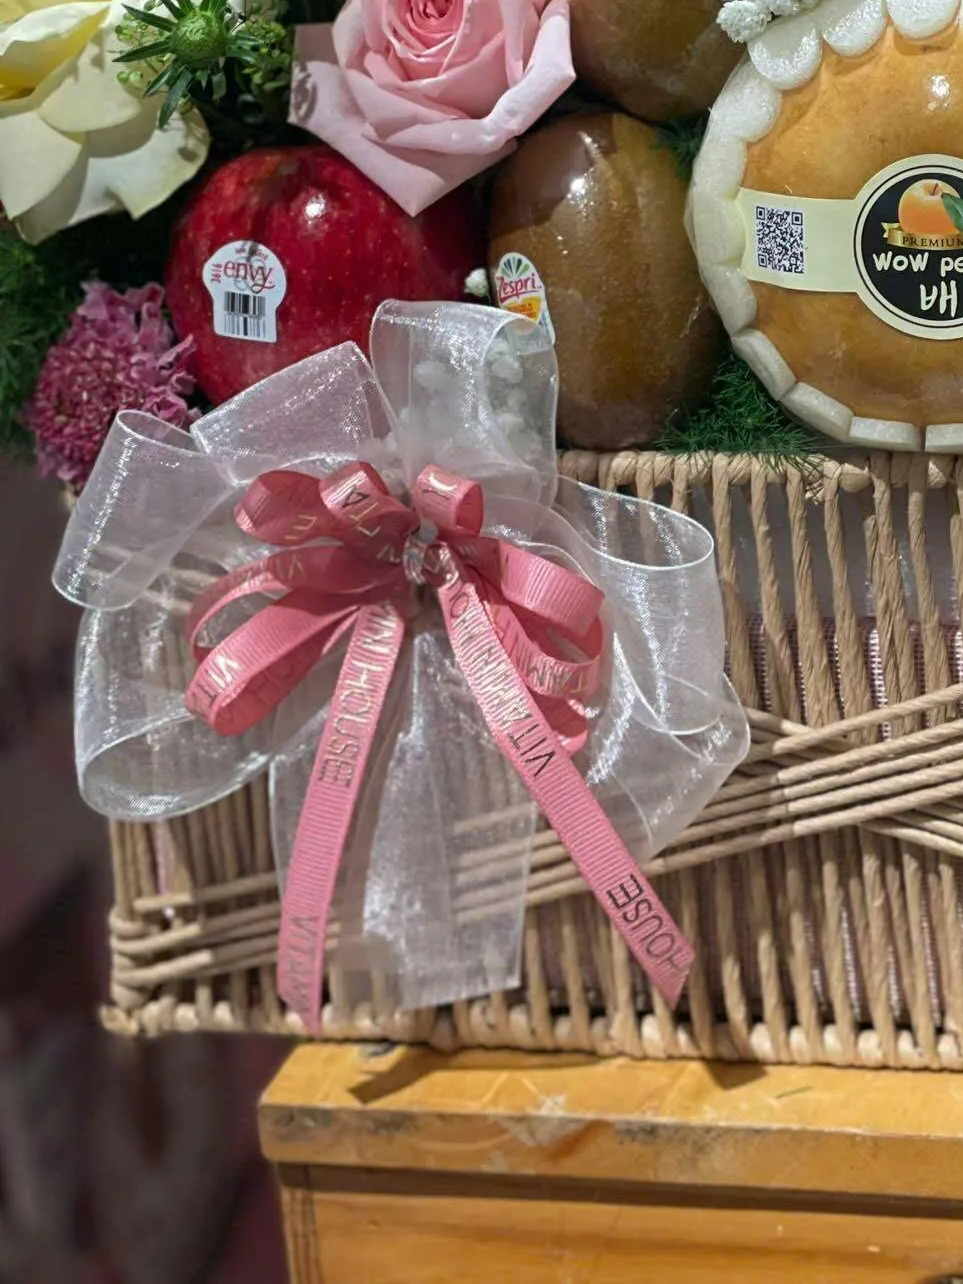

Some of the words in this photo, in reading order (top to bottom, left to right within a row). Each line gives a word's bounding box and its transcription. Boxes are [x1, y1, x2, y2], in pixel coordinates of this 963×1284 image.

[223, 260, 277, 294] envy
[496, 272, 540, 304] Zespri
[317, 659, 390, 788] HOUSE
